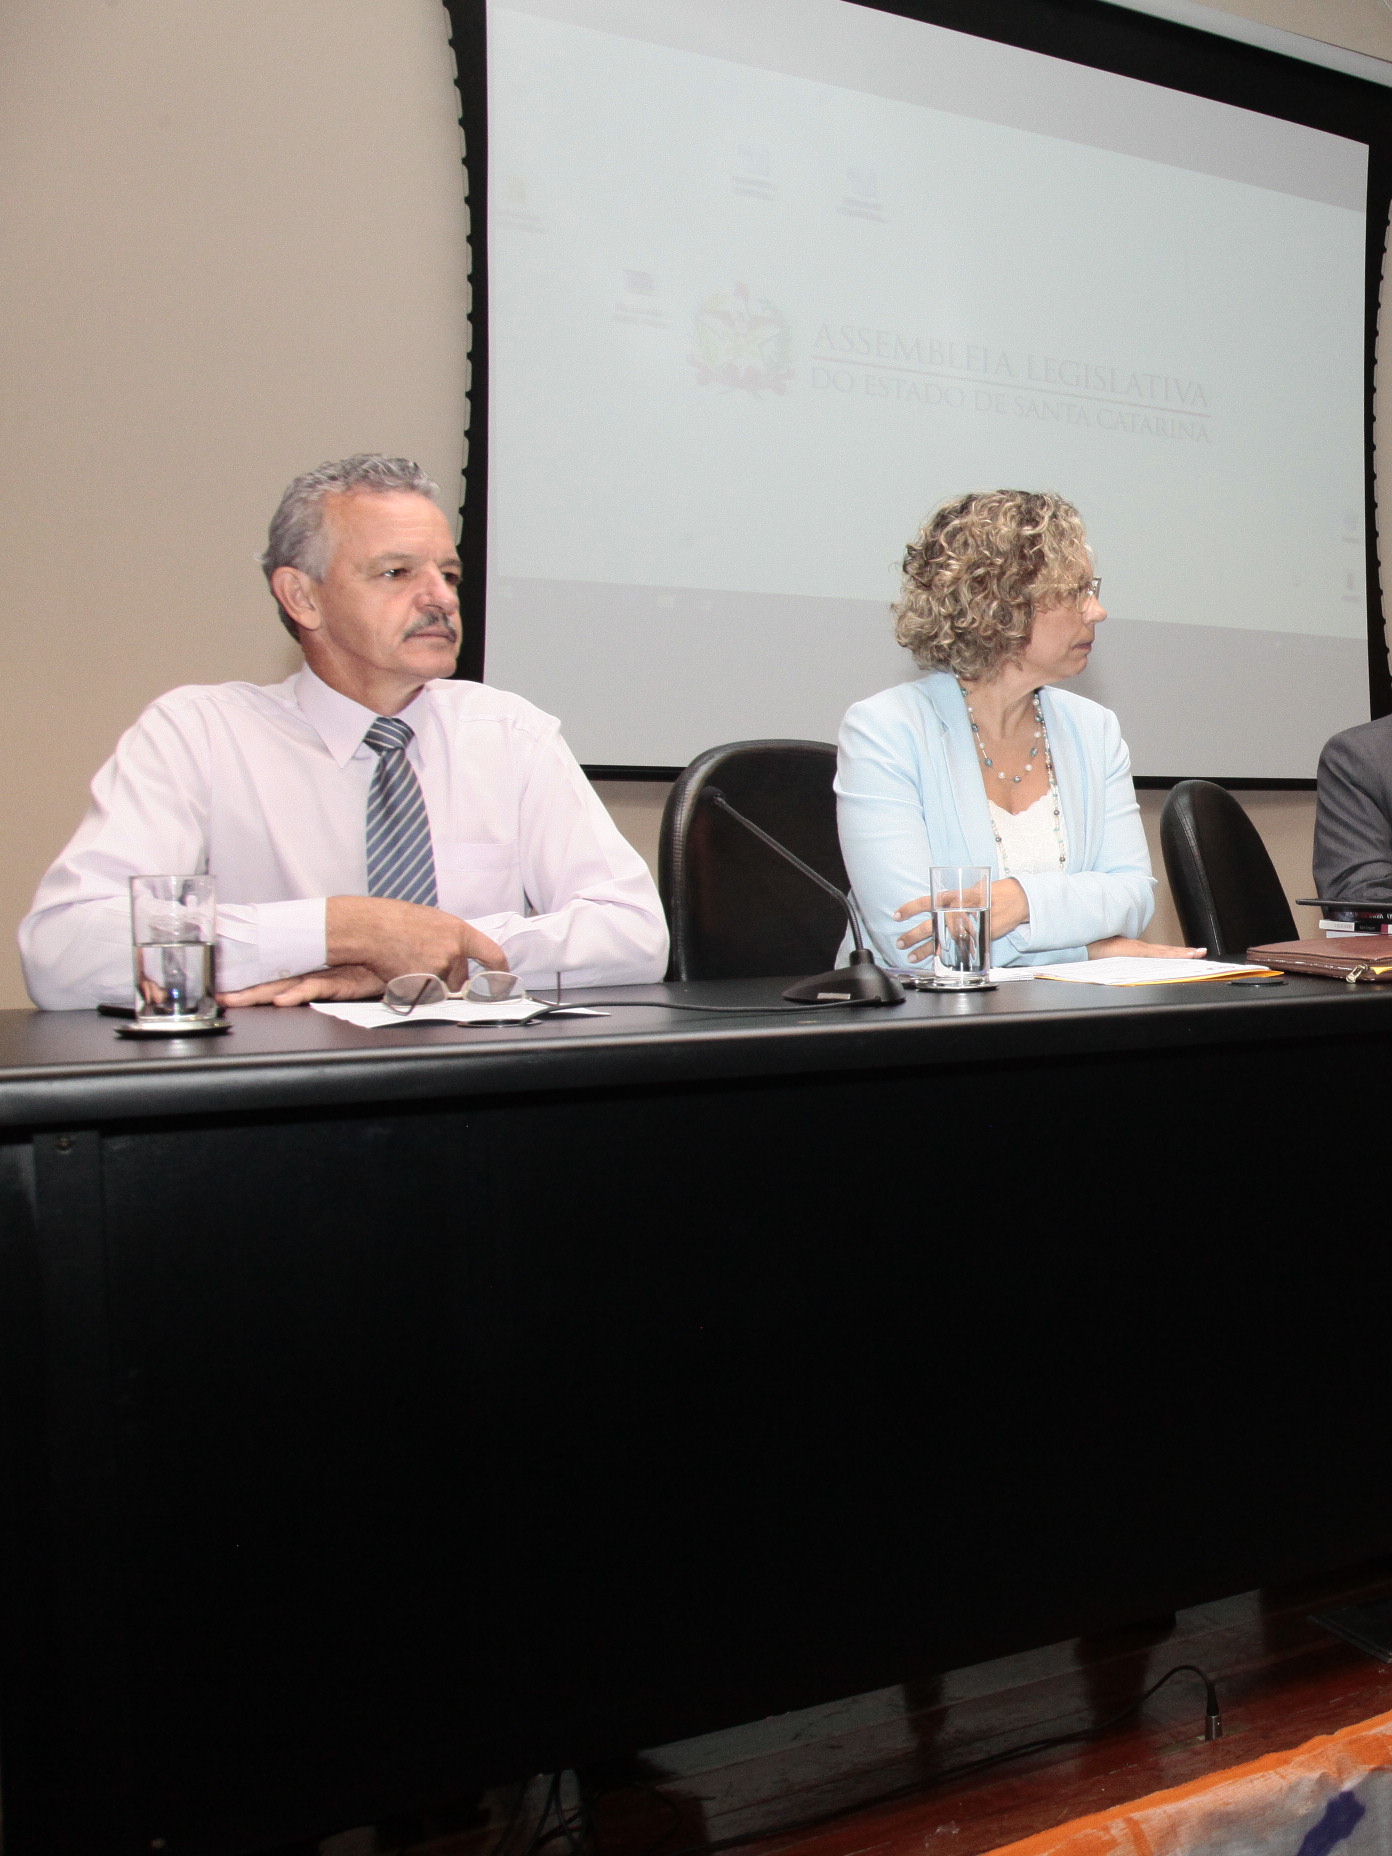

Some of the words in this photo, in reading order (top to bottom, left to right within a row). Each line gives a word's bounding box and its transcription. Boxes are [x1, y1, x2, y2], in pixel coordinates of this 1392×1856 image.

[811, 366, 855, 393] DO
[864, 375, 965, 409] ESTADO
[974, 390, 1007, 414] DE
[1013, 395, 1090, 424] SANTA
[1096, 407, 1213, 444] CATARINA
[813, 322, 1014, 378] ASSEMBLEIA
[1027, 354, 1211, 409] LEGISLATIVA
